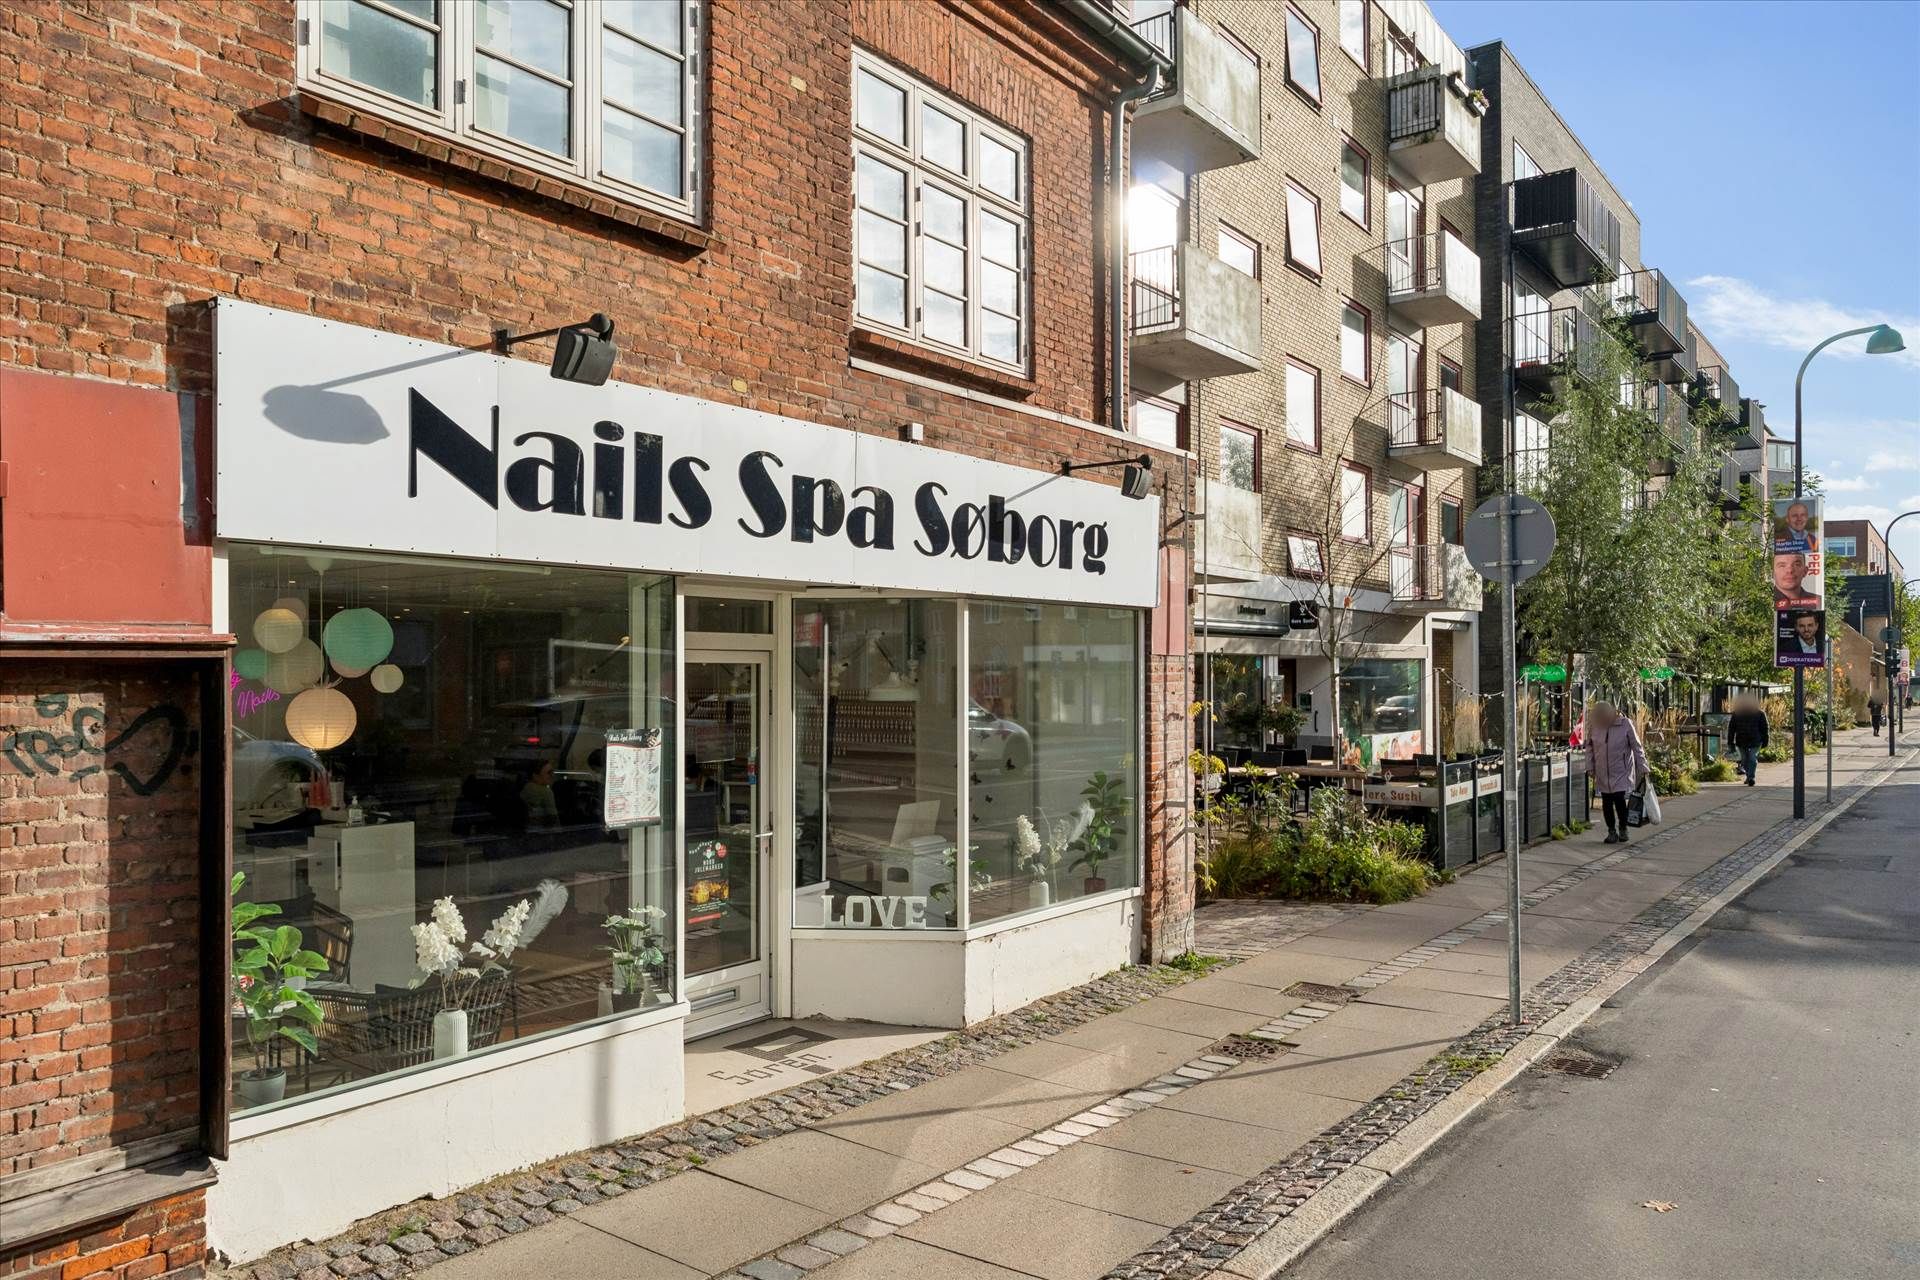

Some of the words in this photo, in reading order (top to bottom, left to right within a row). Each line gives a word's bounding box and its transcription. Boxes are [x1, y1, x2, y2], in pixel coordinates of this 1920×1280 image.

[408, 386, 712, 530] Nails
[737, 450, 895, 551] Spa
[913, 481, 1109, 576] Søborg
[1808, 554, 1820, 576] PER
[1390, 790, 1422, 803] Sushi
[821, 895, 927, 928] LOVE
